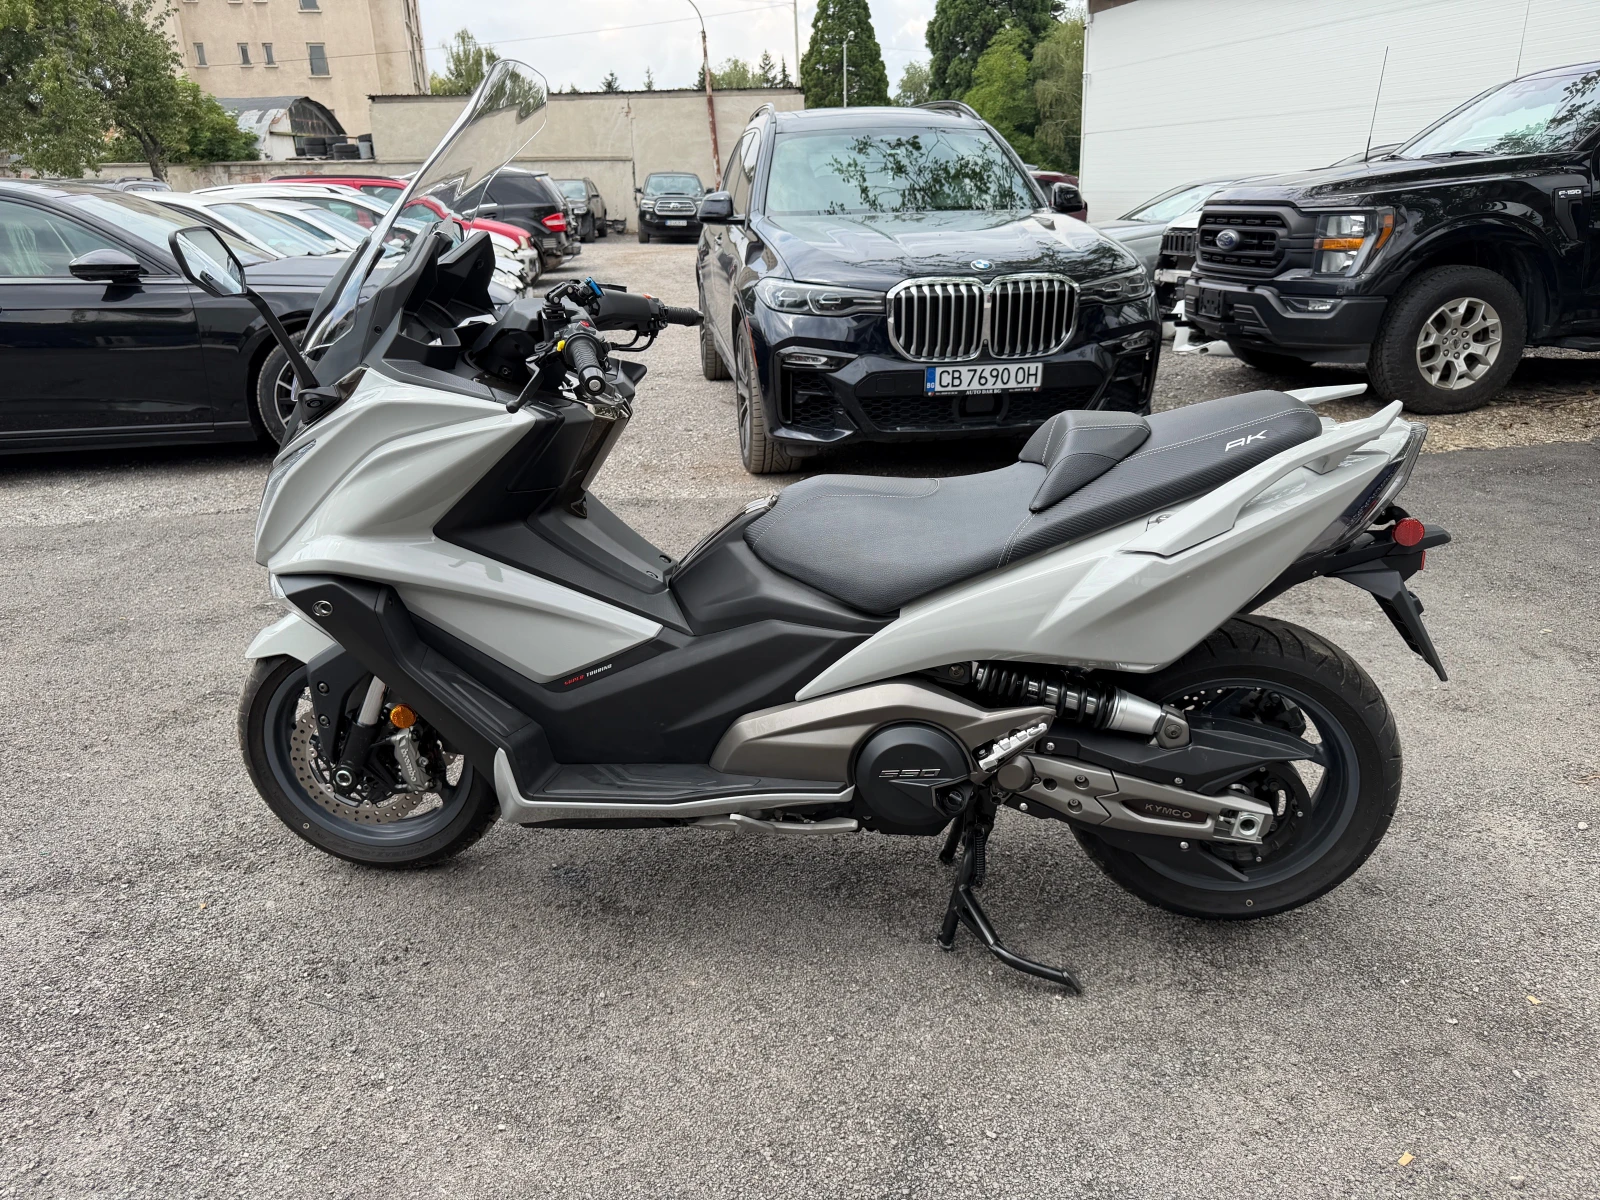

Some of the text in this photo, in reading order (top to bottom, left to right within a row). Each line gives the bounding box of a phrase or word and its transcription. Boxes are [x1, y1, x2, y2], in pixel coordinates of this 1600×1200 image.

[938, 365, 1039, 389] CB 7690 OH
[1224, 429, 1268, 452] AK
[585, 663, 613, 677] TOURING
[1144, 803, 1192, 819] KYMCO
